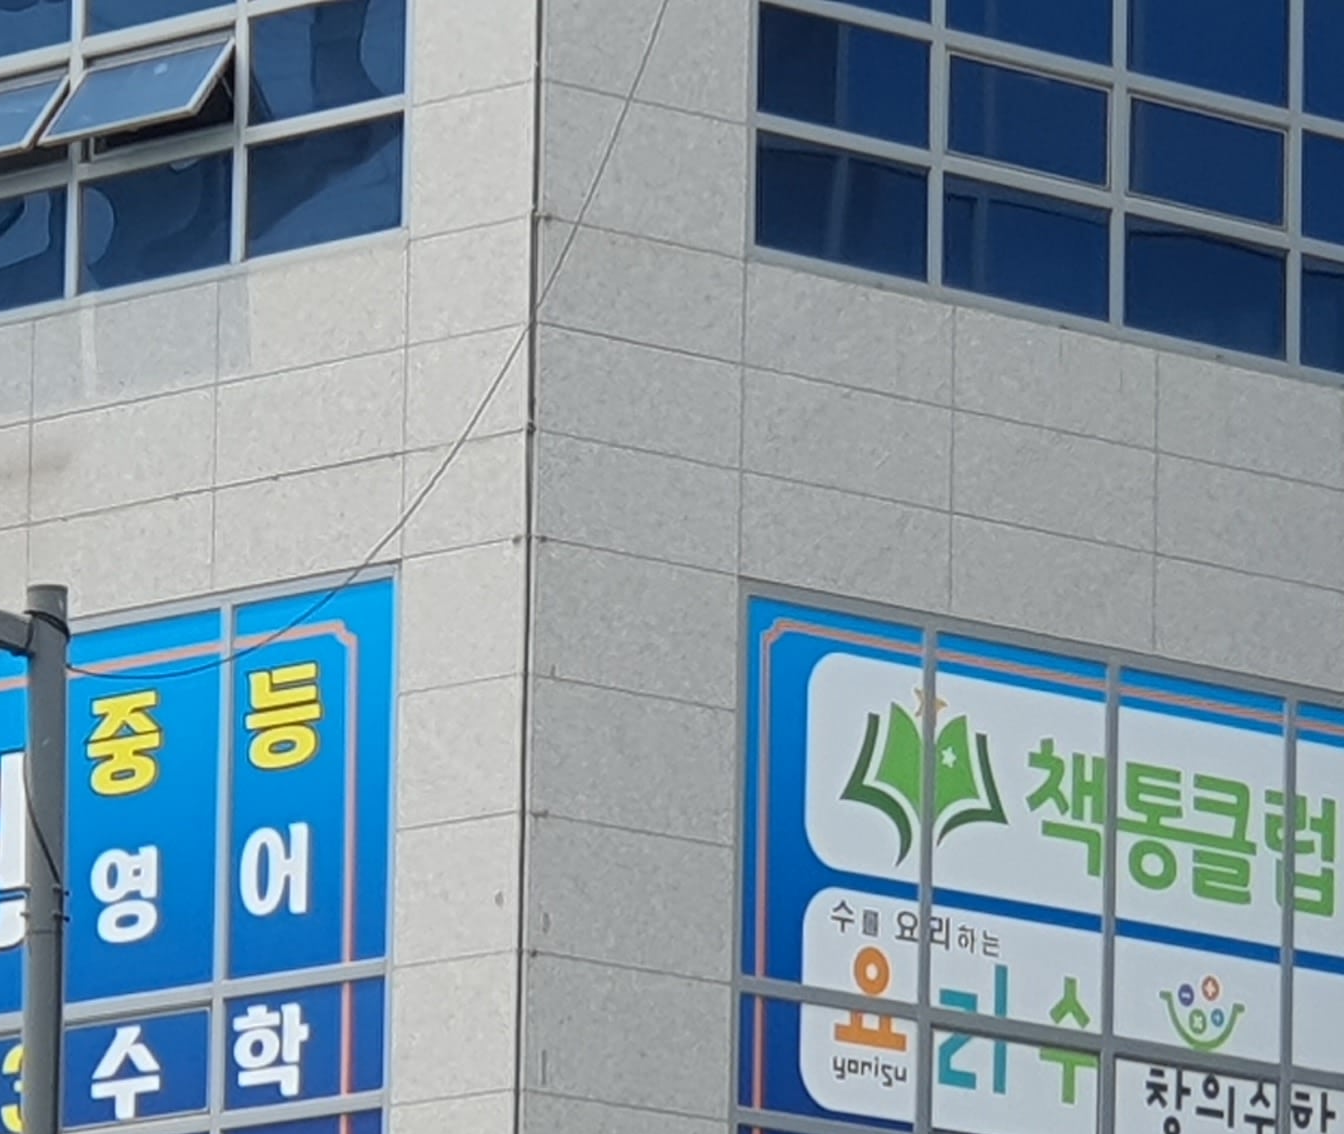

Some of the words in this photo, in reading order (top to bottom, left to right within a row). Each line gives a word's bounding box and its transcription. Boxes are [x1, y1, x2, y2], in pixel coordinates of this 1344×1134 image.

[1024, 736, 1338, 920] 책통클럽
[830, 899, 880, 938] 수를
[894, 910, 1001, 958] 요리하는
[833, 944, 1099, 1104] 요리수
